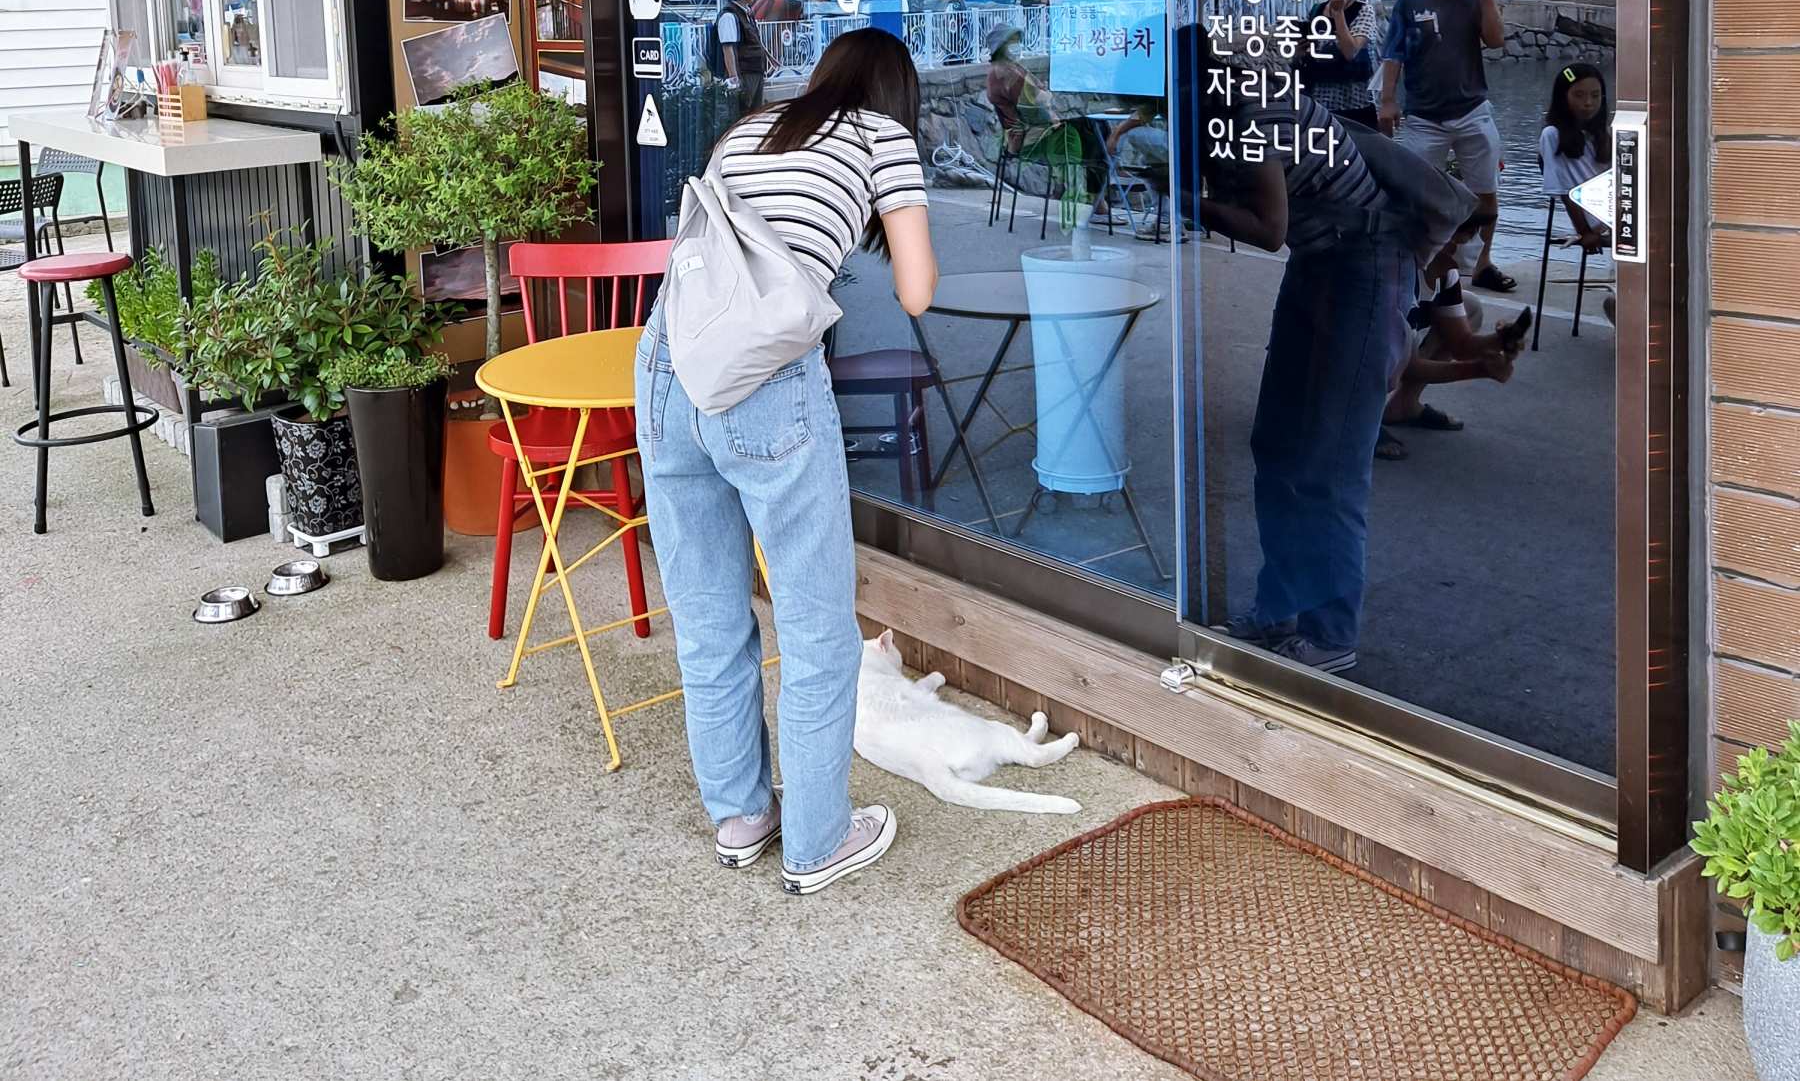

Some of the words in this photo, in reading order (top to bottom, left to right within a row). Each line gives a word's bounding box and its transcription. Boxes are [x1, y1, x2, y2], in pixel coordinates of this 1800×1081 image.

[639, 49, 659, 61] CARD
[1088, 27, 1155, 58] 쌍화차
[1207, 15, 1337, 59] 전망좋은
[1206, 67, 1305, 110] 자리가
[1208, 118, 1351, 167] 있습니다.
